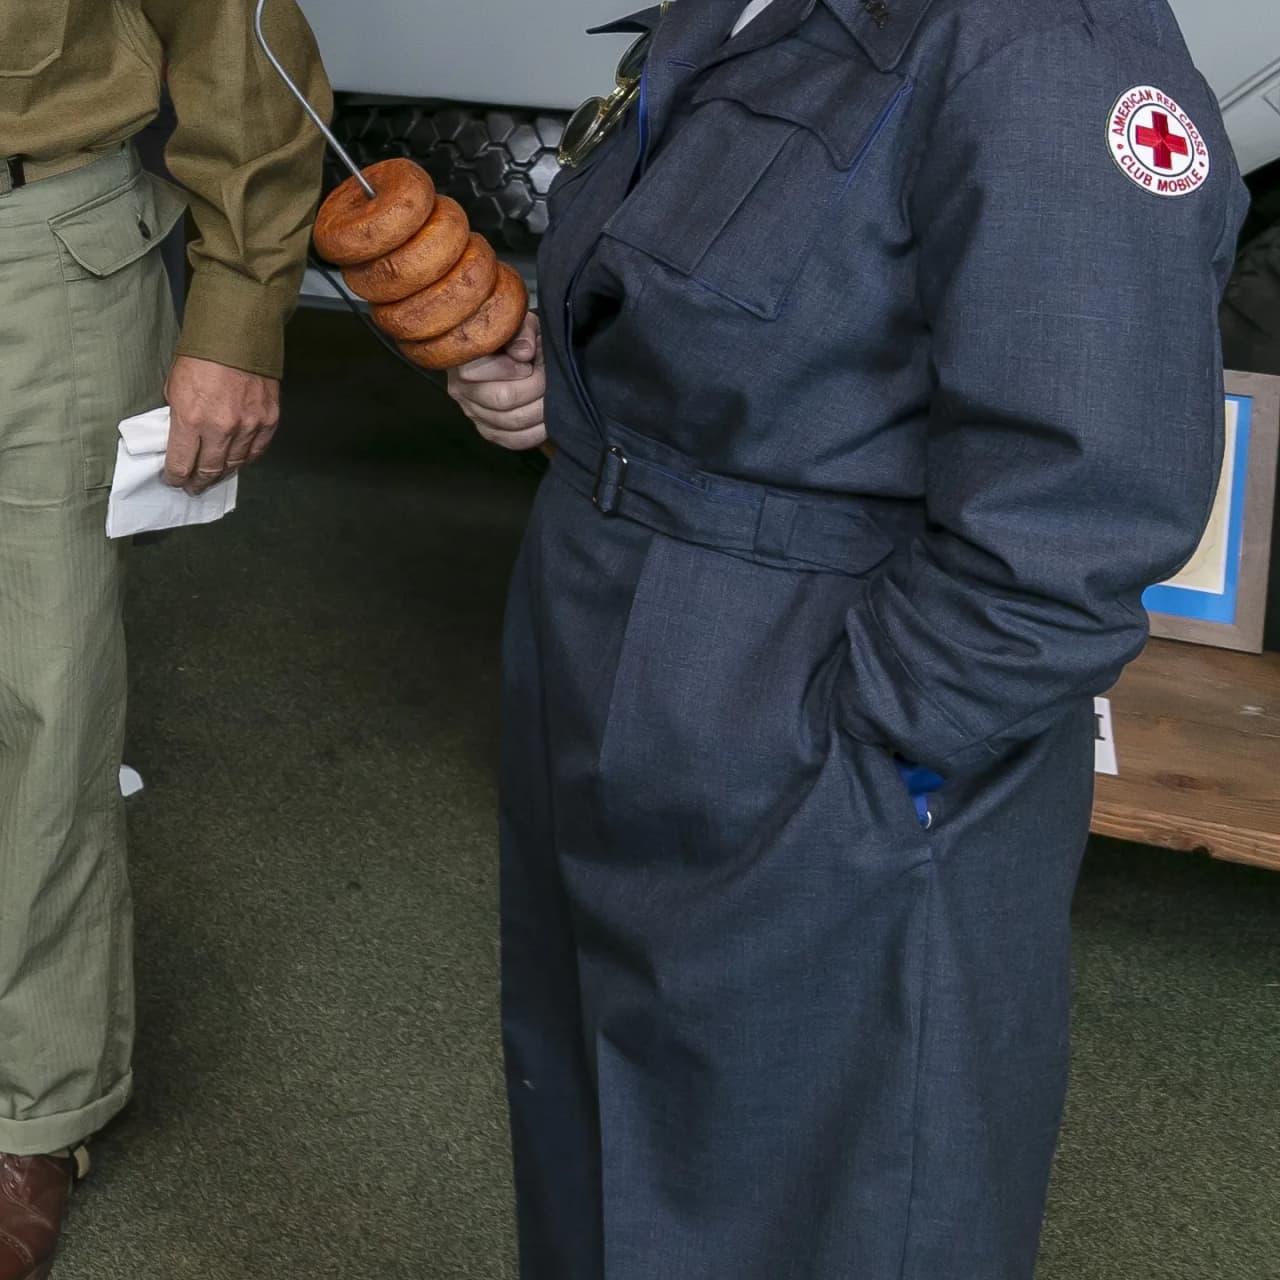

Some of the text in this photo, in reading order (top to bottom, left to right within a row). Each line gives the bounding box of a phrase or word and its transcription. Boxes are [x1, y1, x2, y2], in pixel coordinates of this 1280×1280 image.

[1111, 88, 1208, 158] AMERICAN RED CROSS
[1120, 154, 1204, 193] CLUB MOBILE
